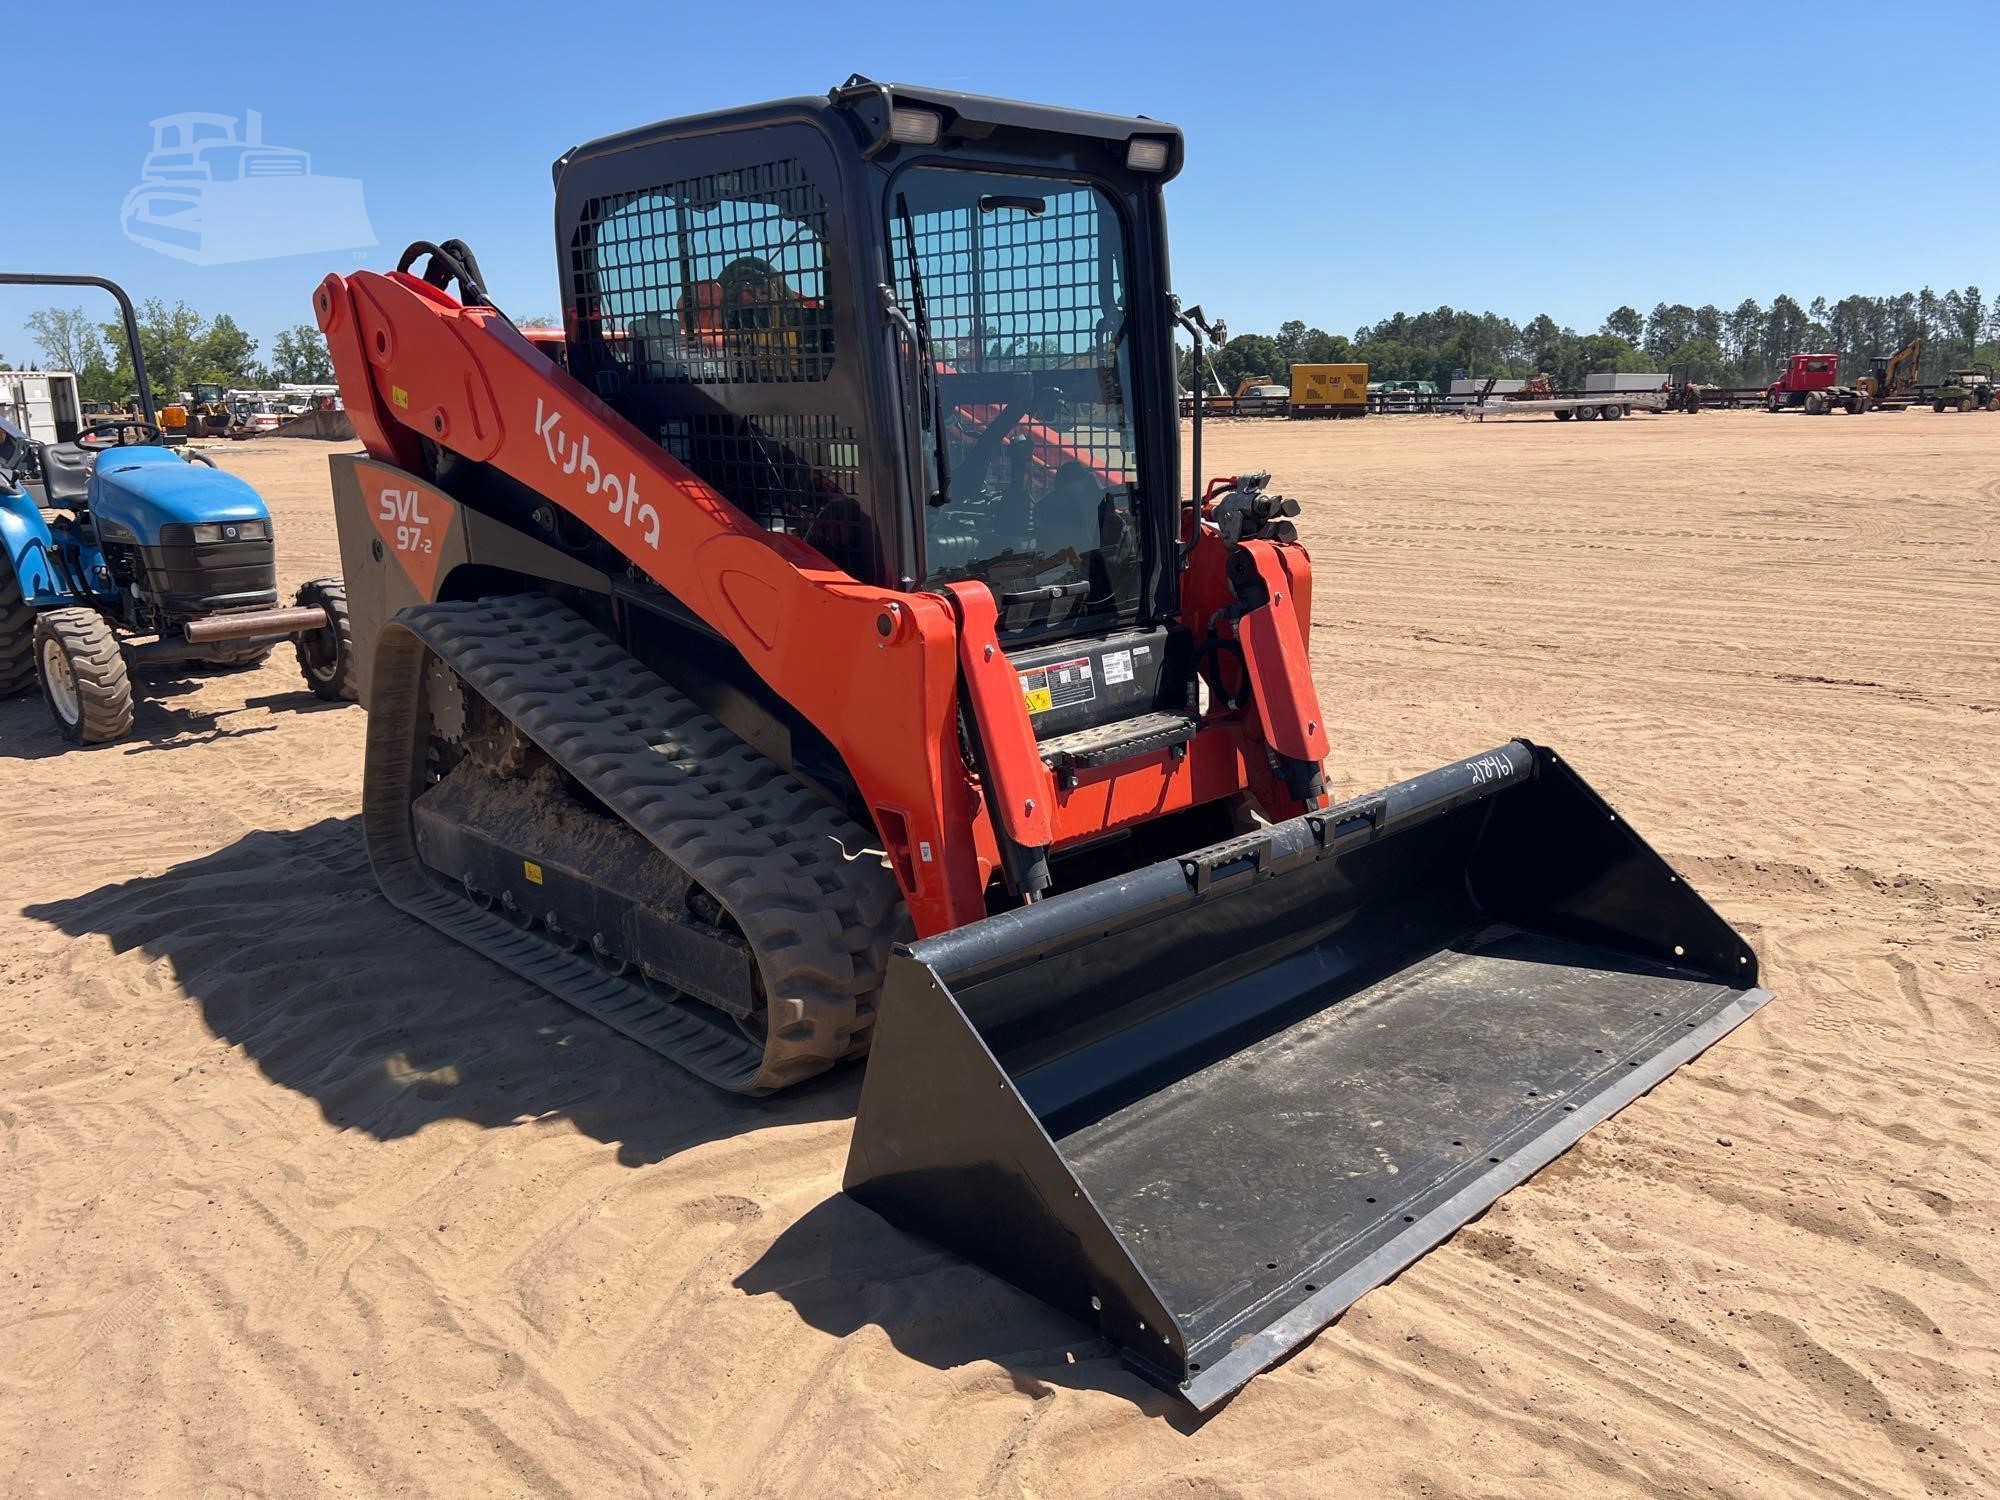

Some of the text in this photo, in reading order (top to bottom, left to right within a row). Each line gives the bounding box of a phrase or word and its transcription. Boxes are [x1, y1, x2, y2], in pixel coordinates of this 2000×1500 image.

[1329, 376, 1341, 384] CAT
[535, 398, 660, 550] Kubota
[380, 489, 429, 524] SVL
[1465, 753, 1513, 784] 218461
